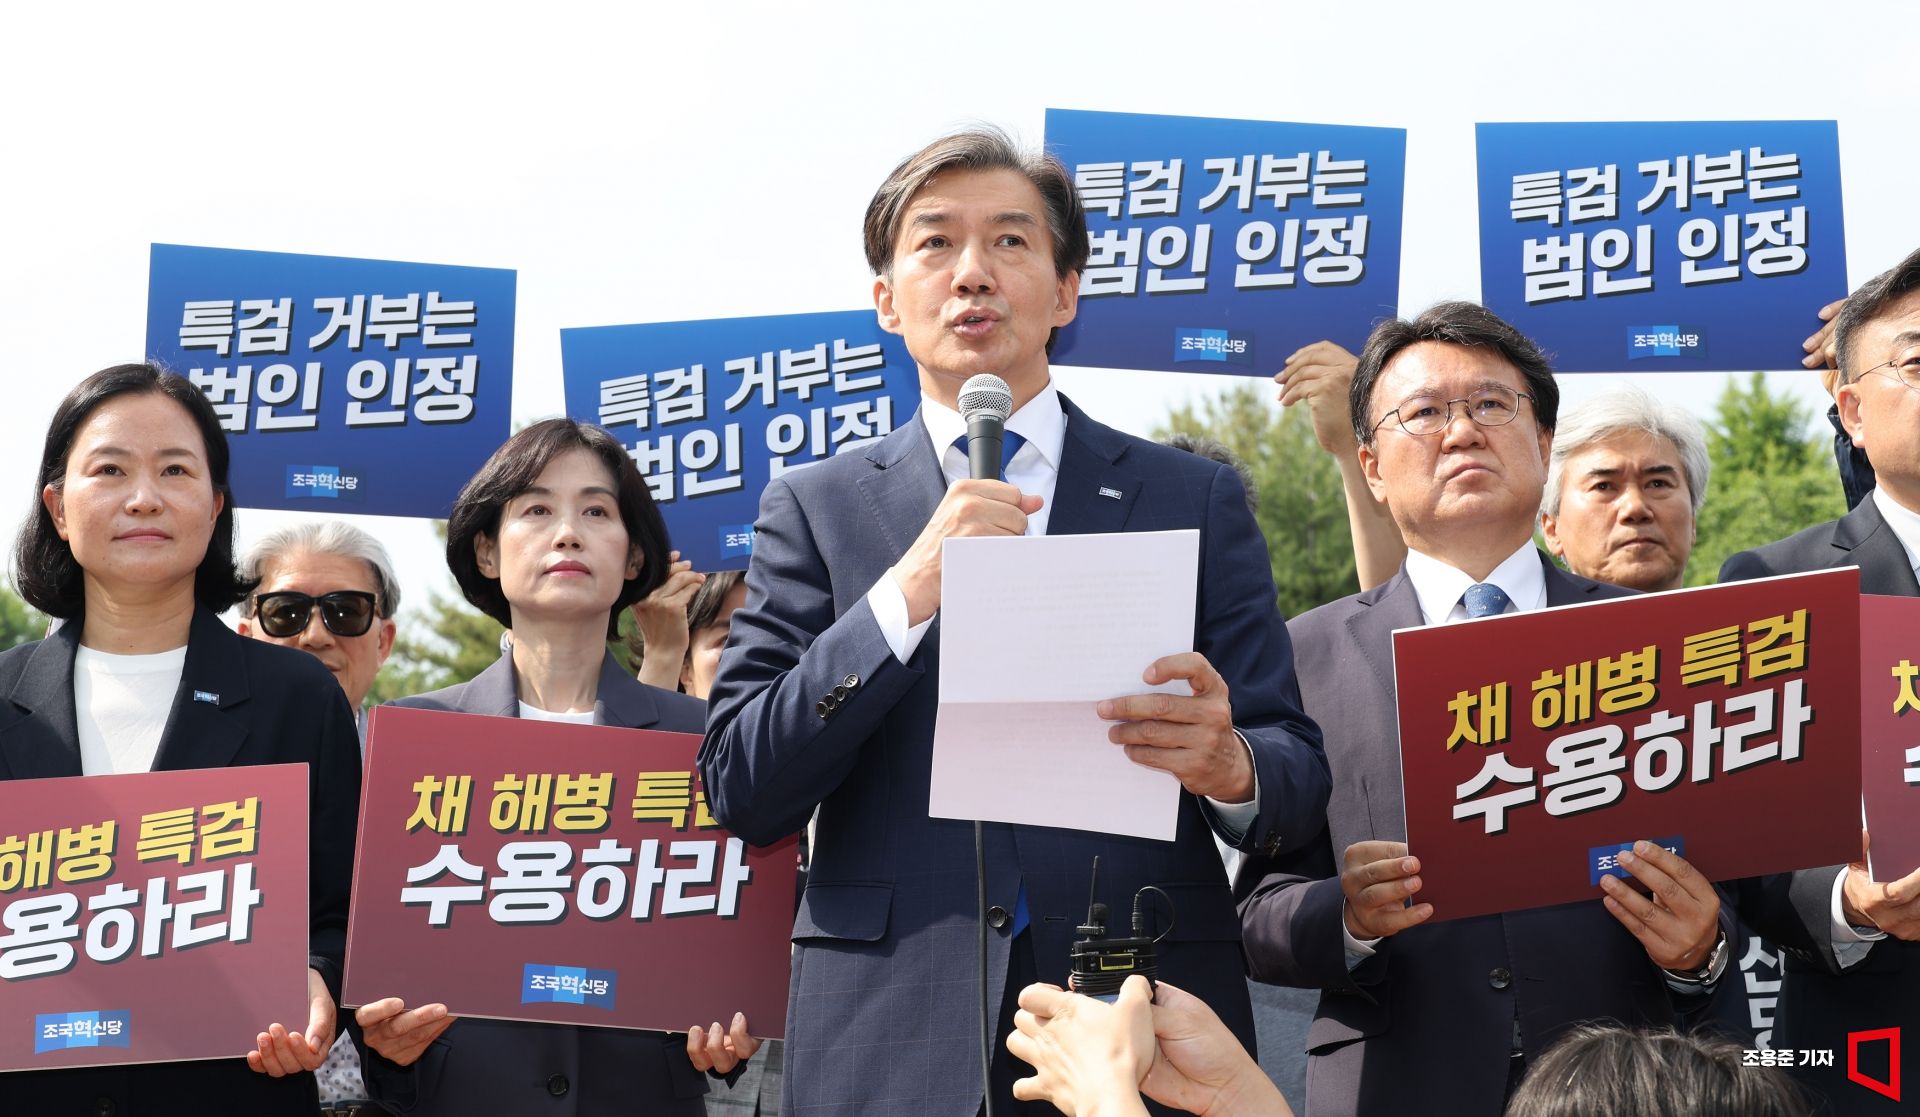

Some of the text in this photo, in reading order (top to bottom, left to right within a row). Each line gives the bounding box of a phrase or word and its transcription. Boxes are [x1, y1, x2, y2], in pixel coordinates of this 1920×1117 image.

[1075, 150, 1366, 217] 특검 거부는
[1510, 147, 1799, 224] 특검 거부는
[1078, 215, 1368, 296] 범인 인정
[1523, 206, 1806, 302] 범인 인정
[179, 291, 475, 354] 특검 거부는
[1181, 336, 1247, 354] 조국혁신당
[1634, 333, 1699, 348] 조국혁신당
[189, 355, 477, 431] 범인 인정
[598, 339, 883, 429] 특검 거부는
[292, 473, 358, 490] 조국혁신당
[621, 396, 891, 500] 범인 인정
[726, 532, 756, 547] 조국
[1446, 608, 1807, 751] 채 해병 특검
[1452, 678, 1812, 834] 수용하라
[405, 775, 471, 834] 채
[489, 772, 613, 831] 해병
[0, 796, 258, 891] 해병 특검
[400, 837, 749, 925] 수용하라
[0, 862, 260, 979] 용하라
[530, 974, 608, 996] 조국혁신당
[43, 1019, 122, 1039] 조국혁신당
